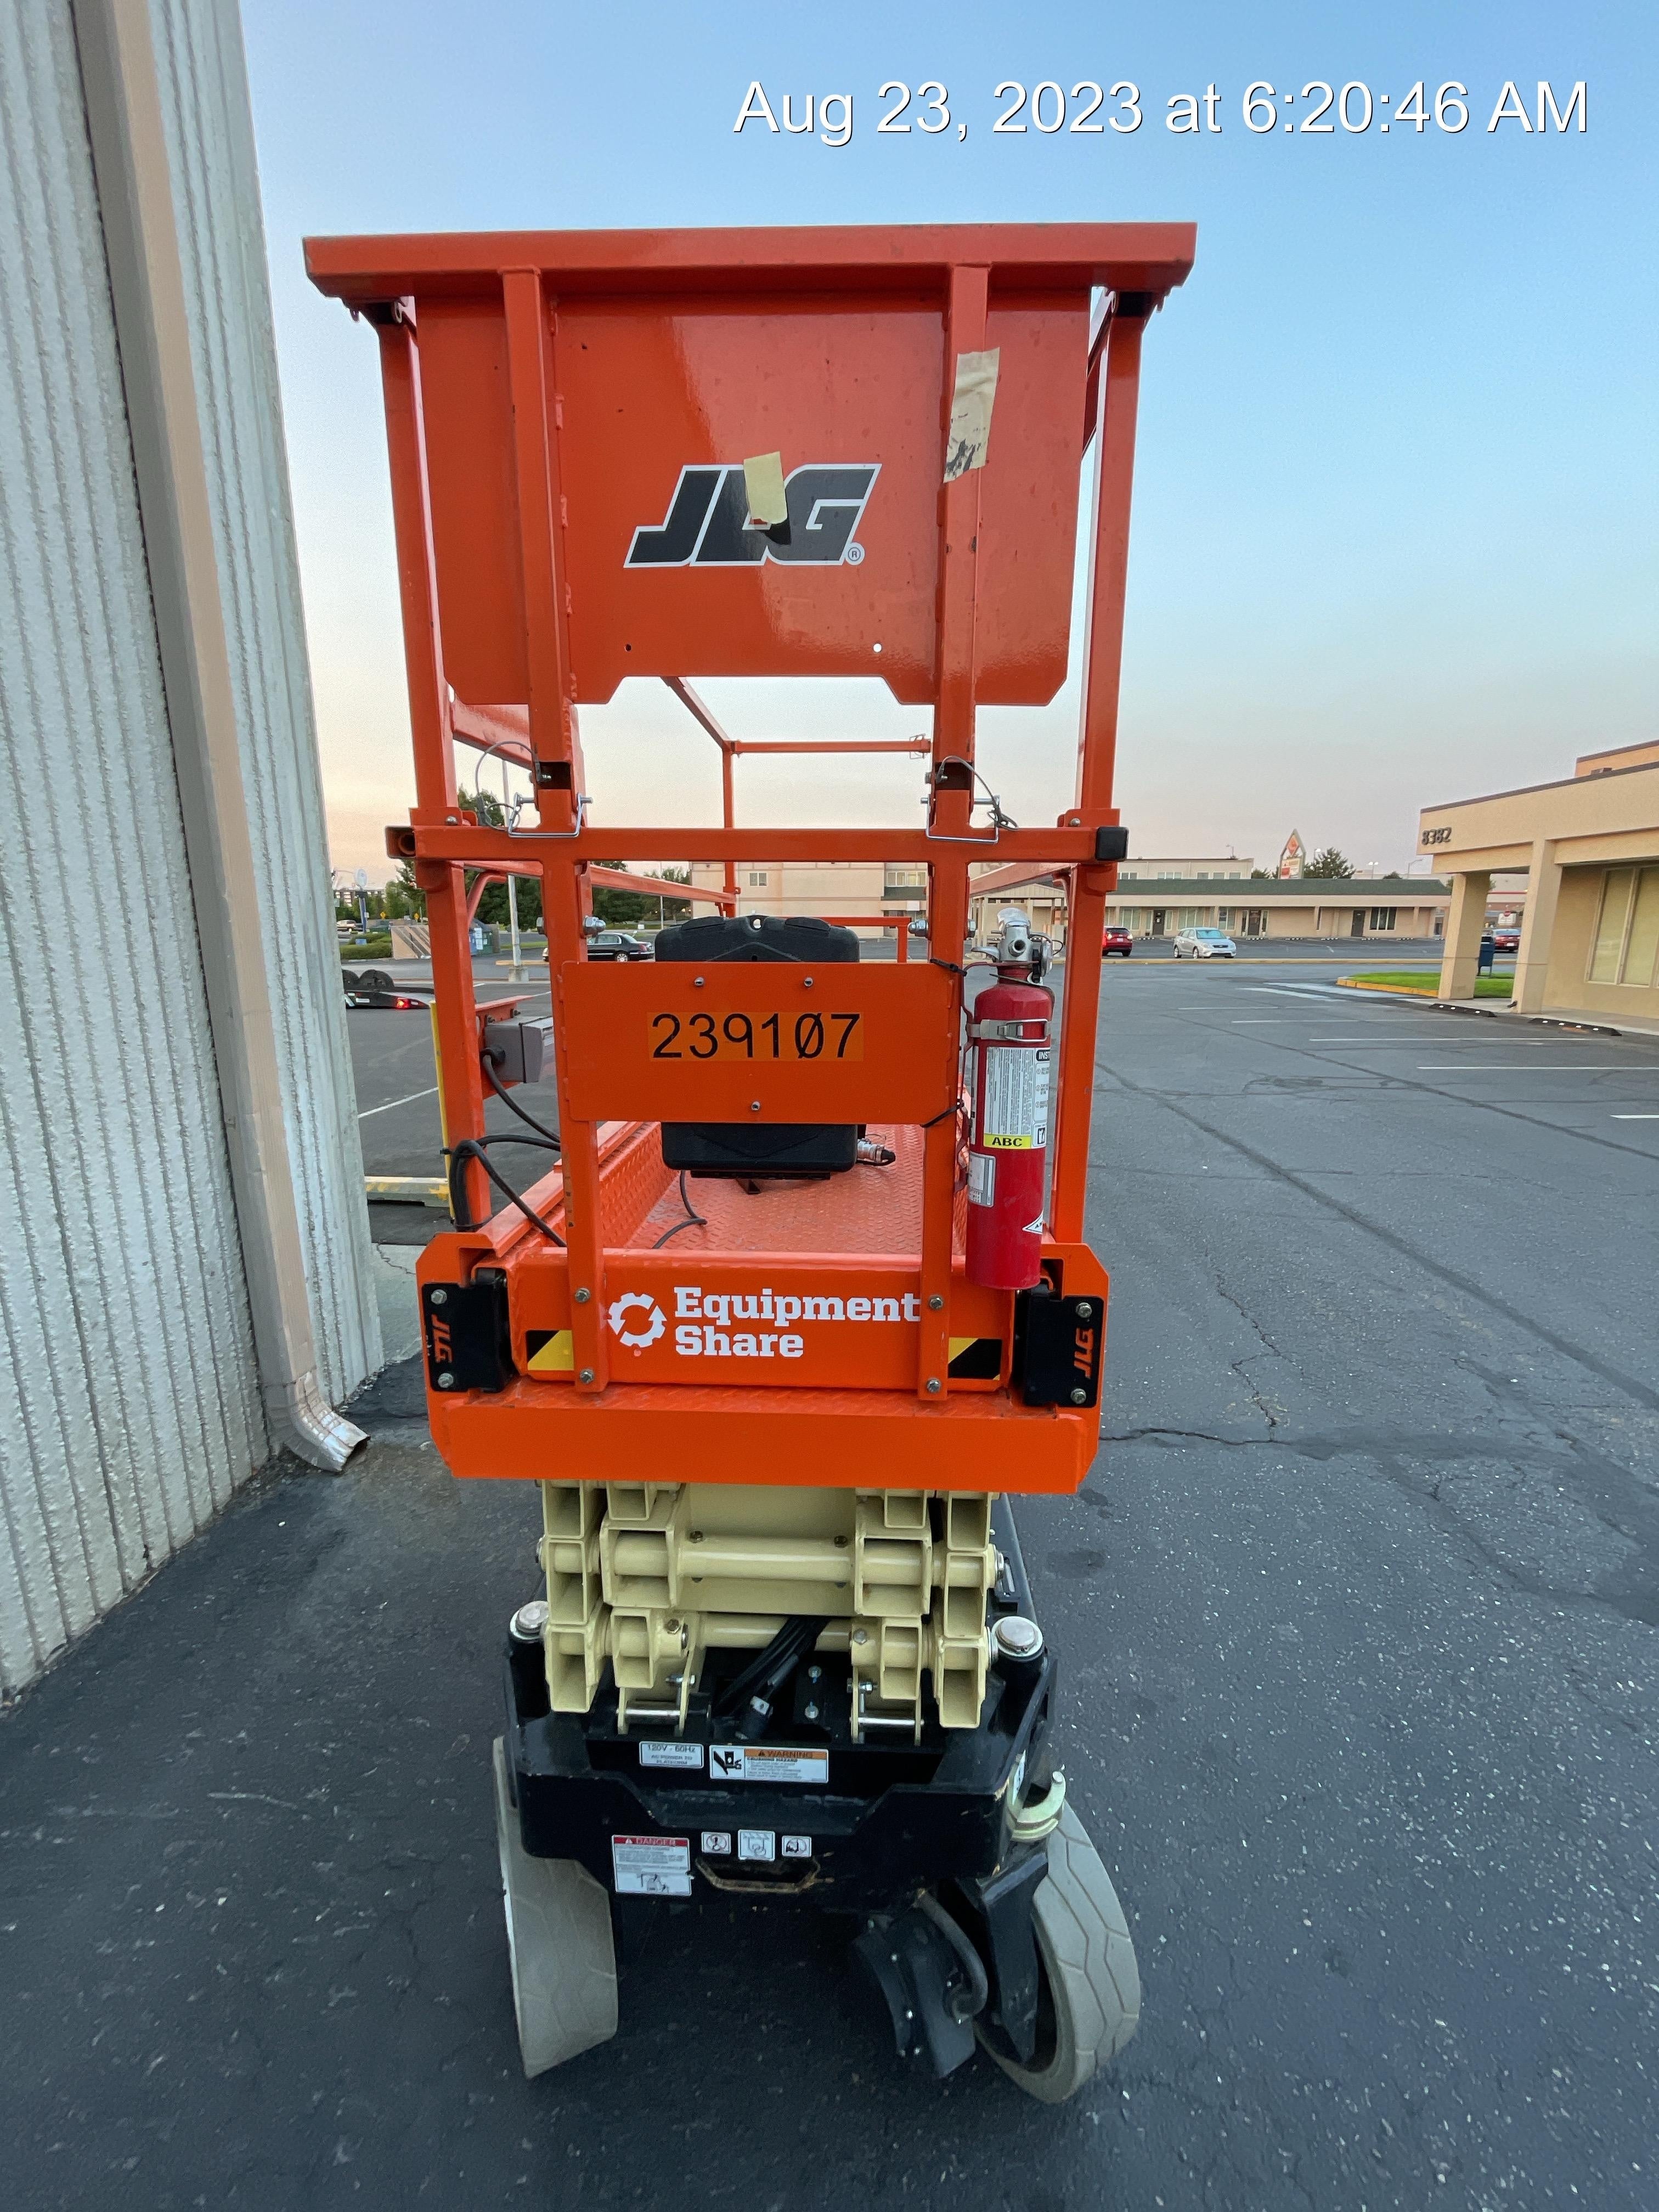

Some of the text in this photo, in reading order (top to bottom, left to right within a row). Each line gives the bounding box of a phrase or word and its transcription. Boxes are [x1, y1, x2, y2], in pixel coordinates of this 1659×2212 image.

[1422, 827, 1451, 845] 8382
[652, 1013, 860, 1058] 239107
[992, 1137, 1022, 1147] ABC
[674, 1286, 921, 1327] Equipment
[431, 1313, 452, 1363] JLG
[675, 1325, 804, 1357] Share
[1074, 1328, 1093, 1379] JLG
[636, 1838, 675, 1847] DANGER
